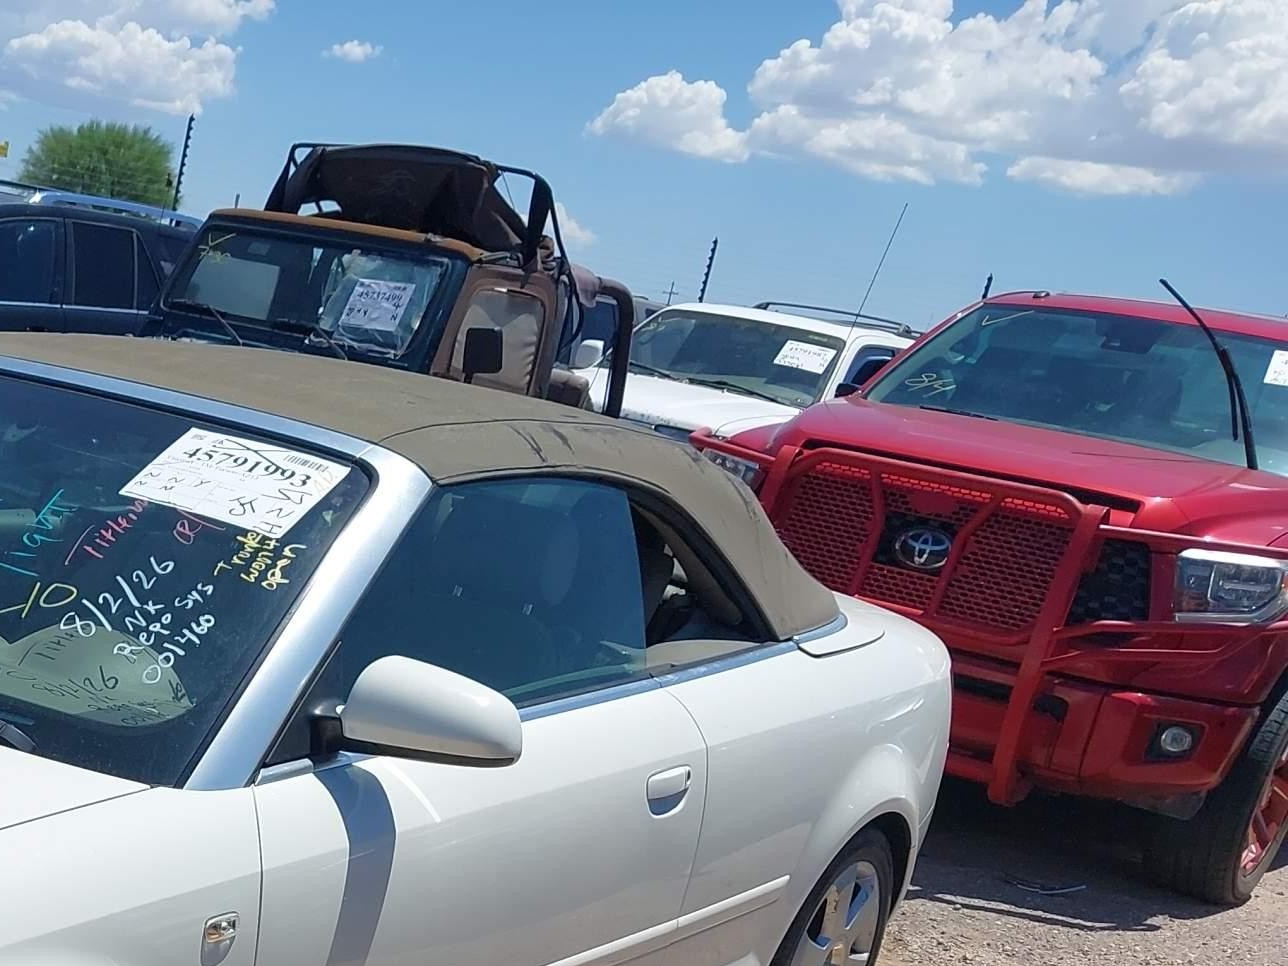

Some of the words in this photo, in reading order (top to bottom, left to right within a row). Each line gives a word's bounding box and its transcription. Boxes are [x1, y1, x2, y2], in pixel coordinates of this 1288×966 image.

[183, 446, 313, 488] 45791993
[59, 556, 175, 638] 8/2/26
[113, 612, 172, 661] Repo
